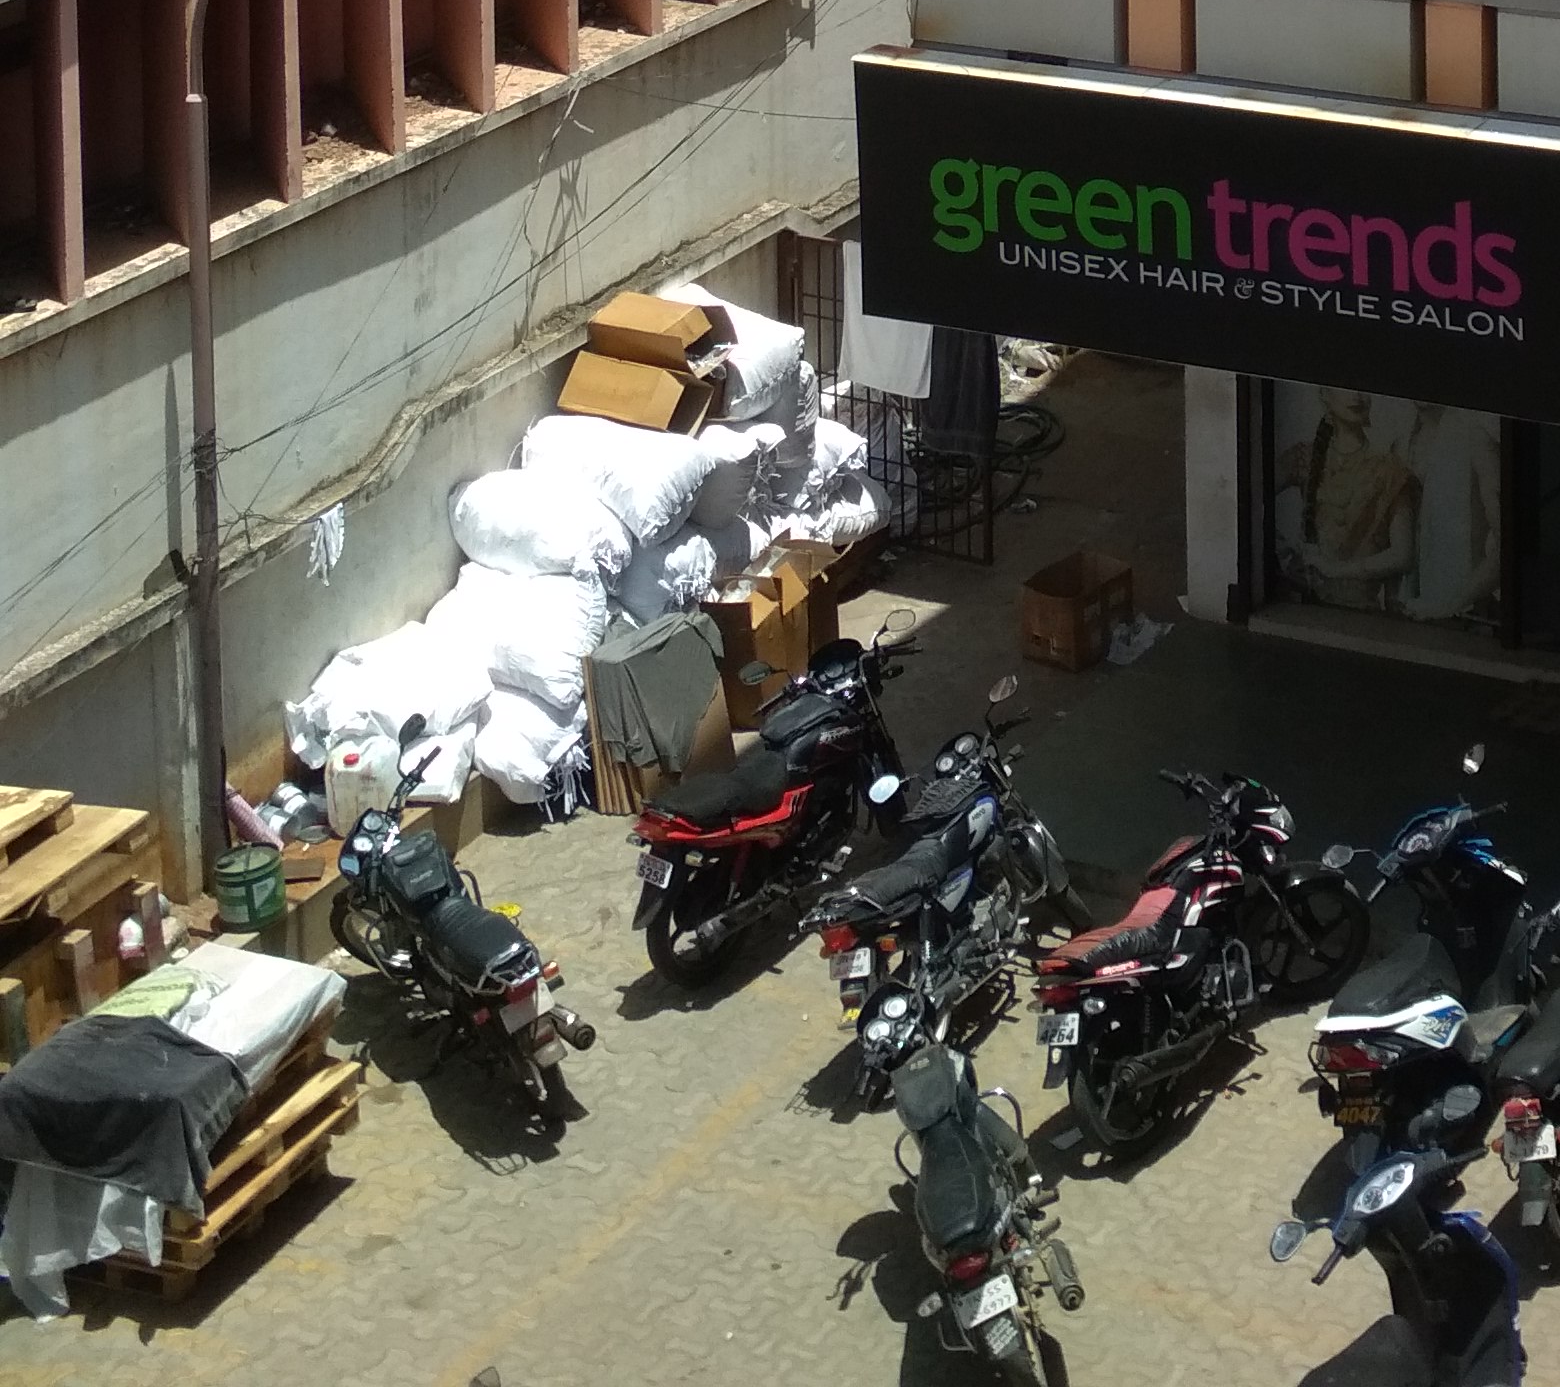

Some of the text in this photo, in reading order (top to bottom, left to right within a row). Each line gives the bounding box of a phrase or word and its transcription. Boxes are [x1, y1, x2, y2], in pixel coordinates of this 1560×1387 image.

[929, 157, 1524, 308] green trends
[998, 241, 1525, 341] UNISEX HAIR & STYLE SALON
